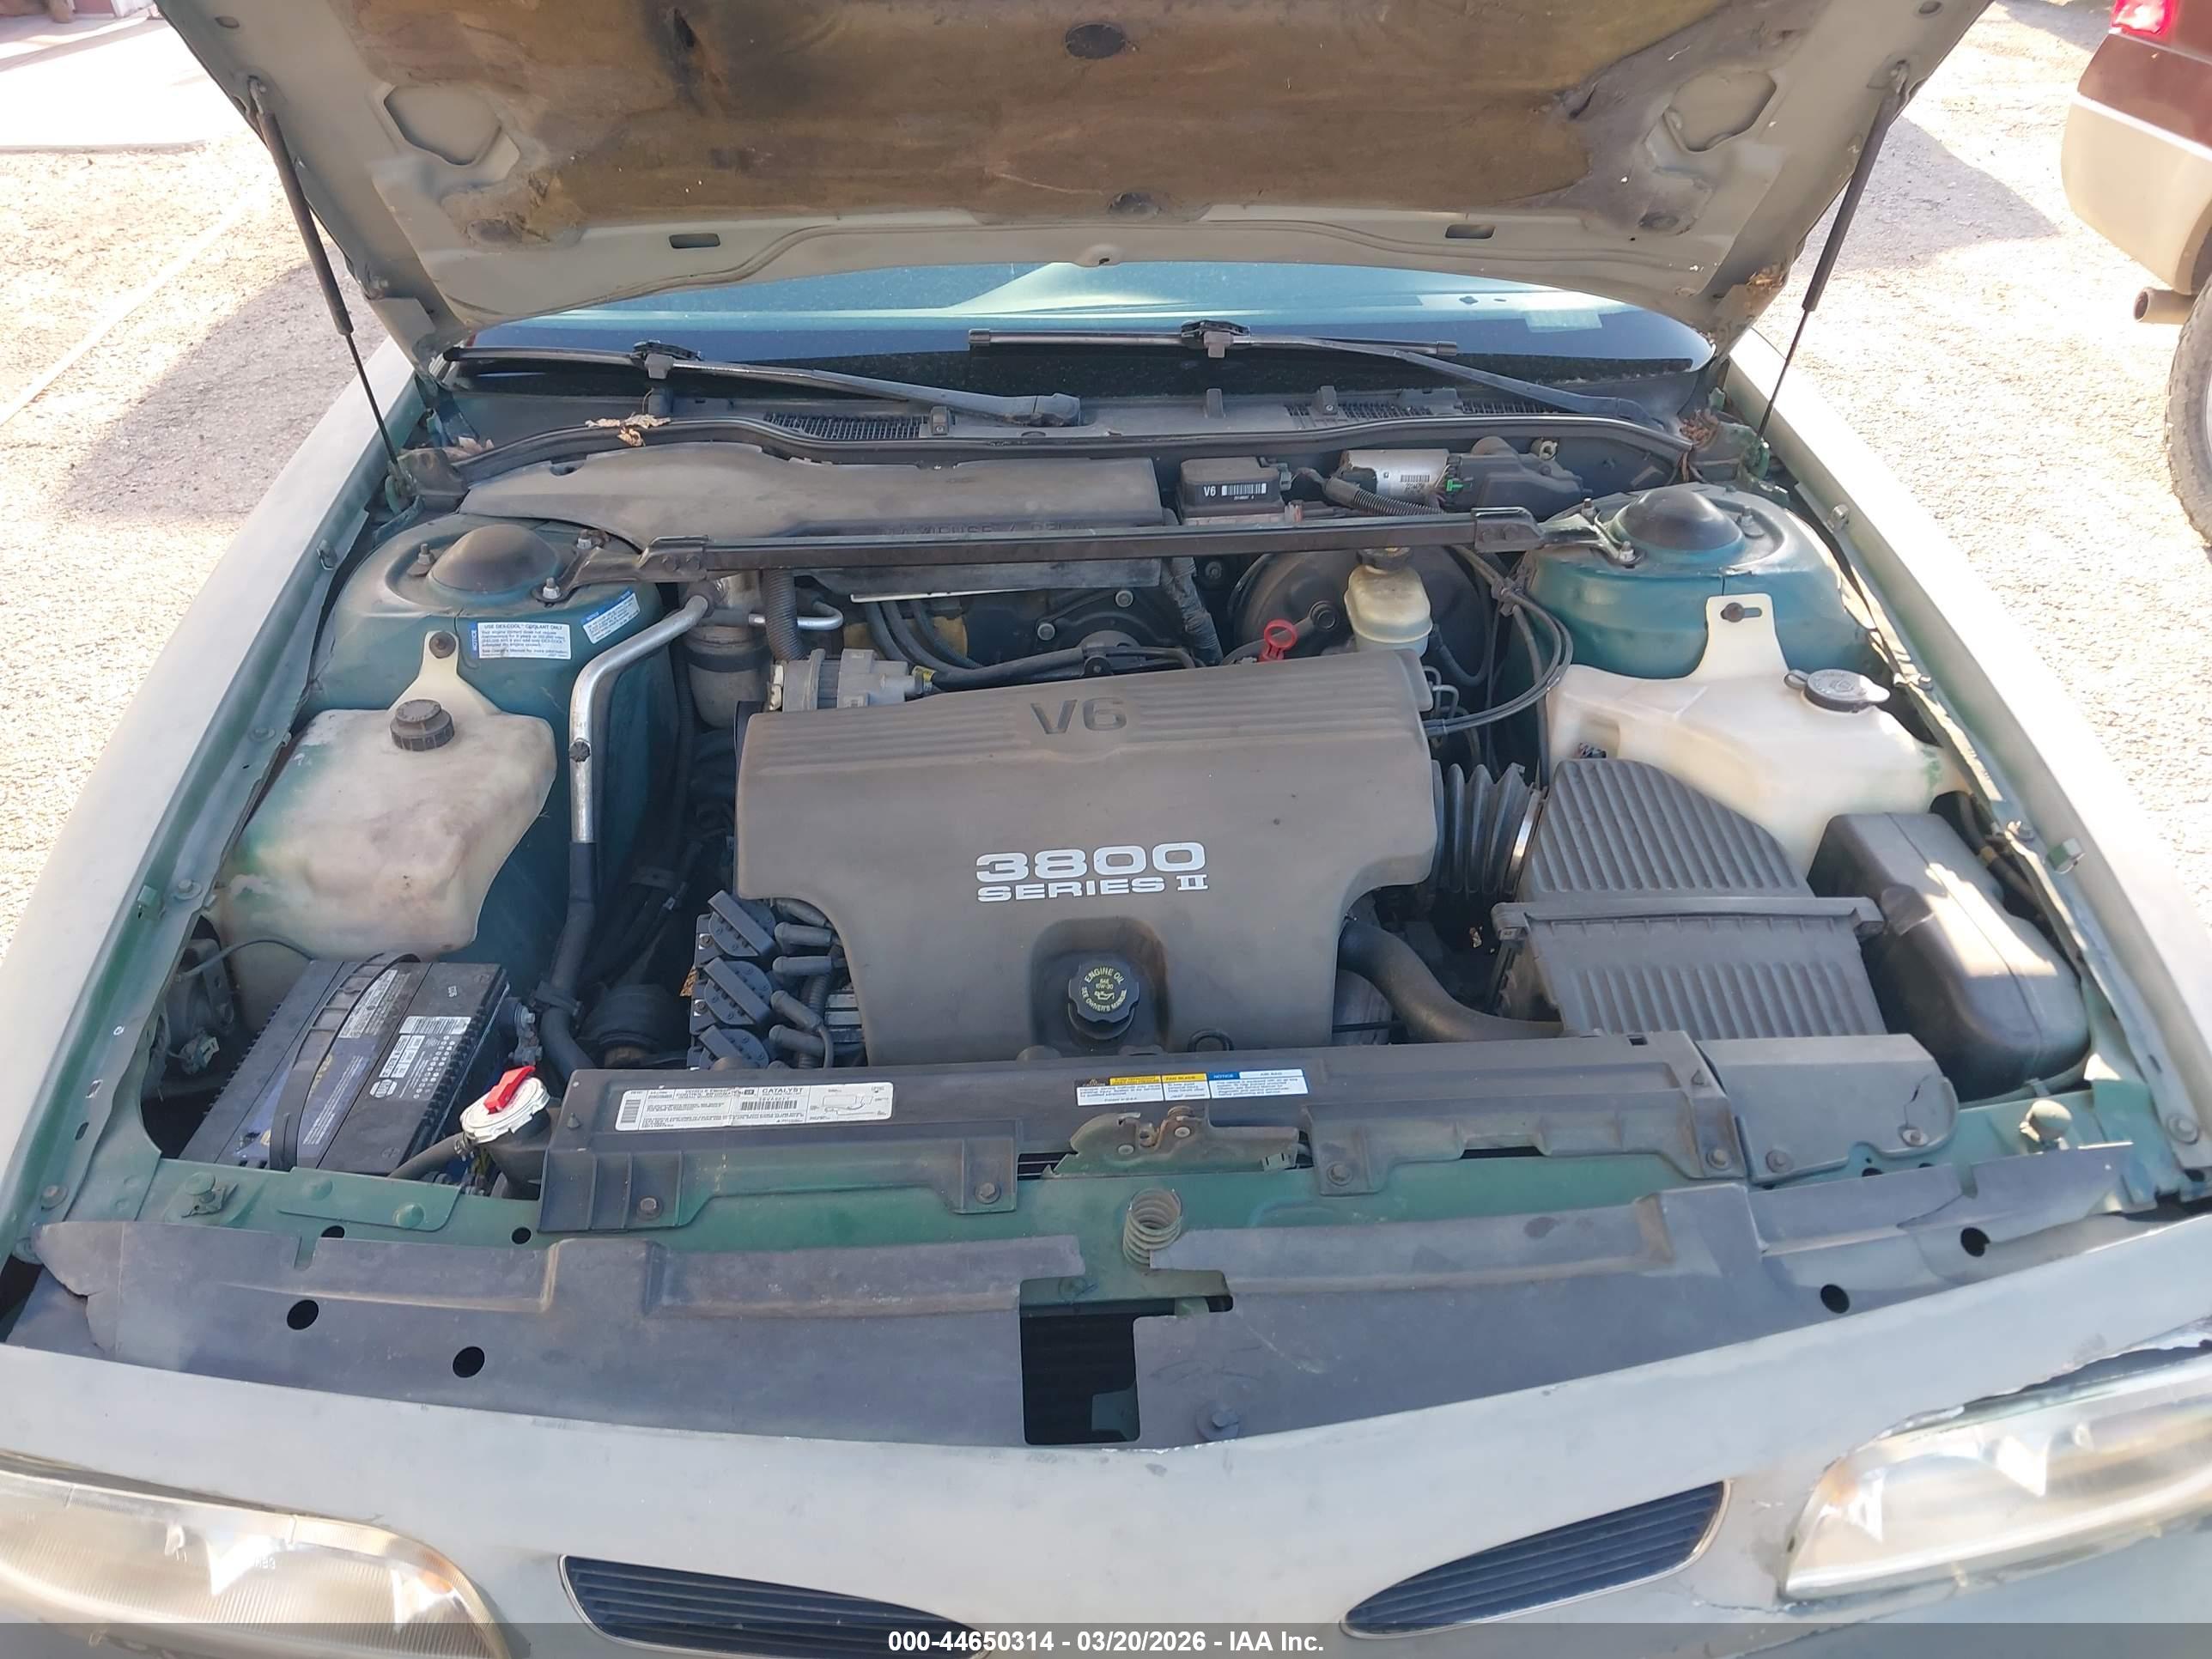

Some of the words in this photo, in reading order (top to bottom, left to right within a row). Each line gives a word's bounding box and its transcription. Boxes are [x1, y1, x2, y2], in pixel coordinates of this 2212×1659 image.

[1203, 485, 1216, 496] V6
[1030, 696, 1127, 735] V6
[975, 842, 1206, 883] 3800
[976, 876, 1166, 902] SERIES
[1176, 873, 1209, 892] II
[1085, 966, 1114, 983] ENGINE
[1114, 971, 1125, 986] OIL
